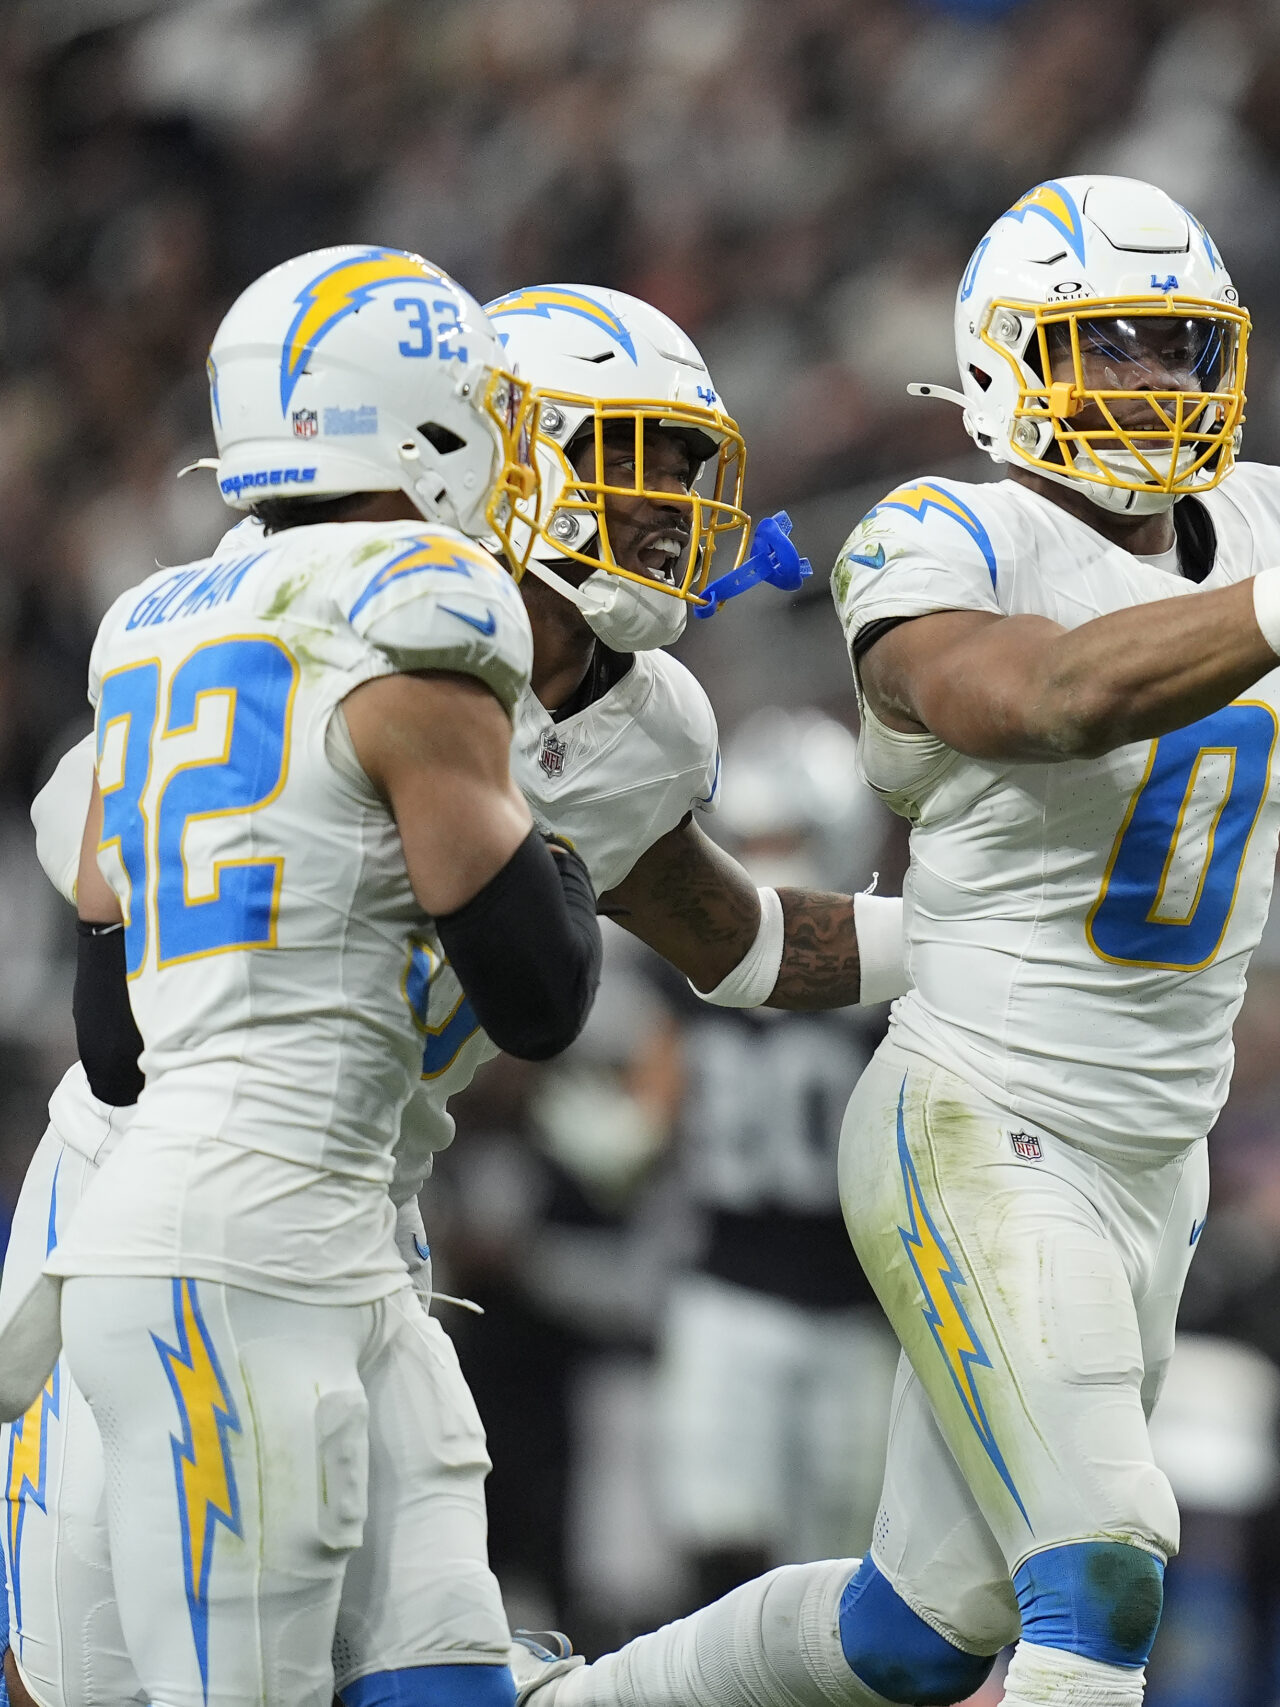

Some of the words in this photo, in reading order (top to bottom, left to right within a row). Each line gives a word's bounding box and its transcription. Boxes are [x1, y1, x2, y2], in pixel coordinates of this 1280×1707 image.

[1047, 292, 1091, 303] OAKLEY
[1150, 274, 1179, 294] LA
[394, 298, 468, 363] 32
[125, 549, 272, 632] GILMAN
[96, 633, 300, 981] 32
[1085, 699, 1280, 973] 0
